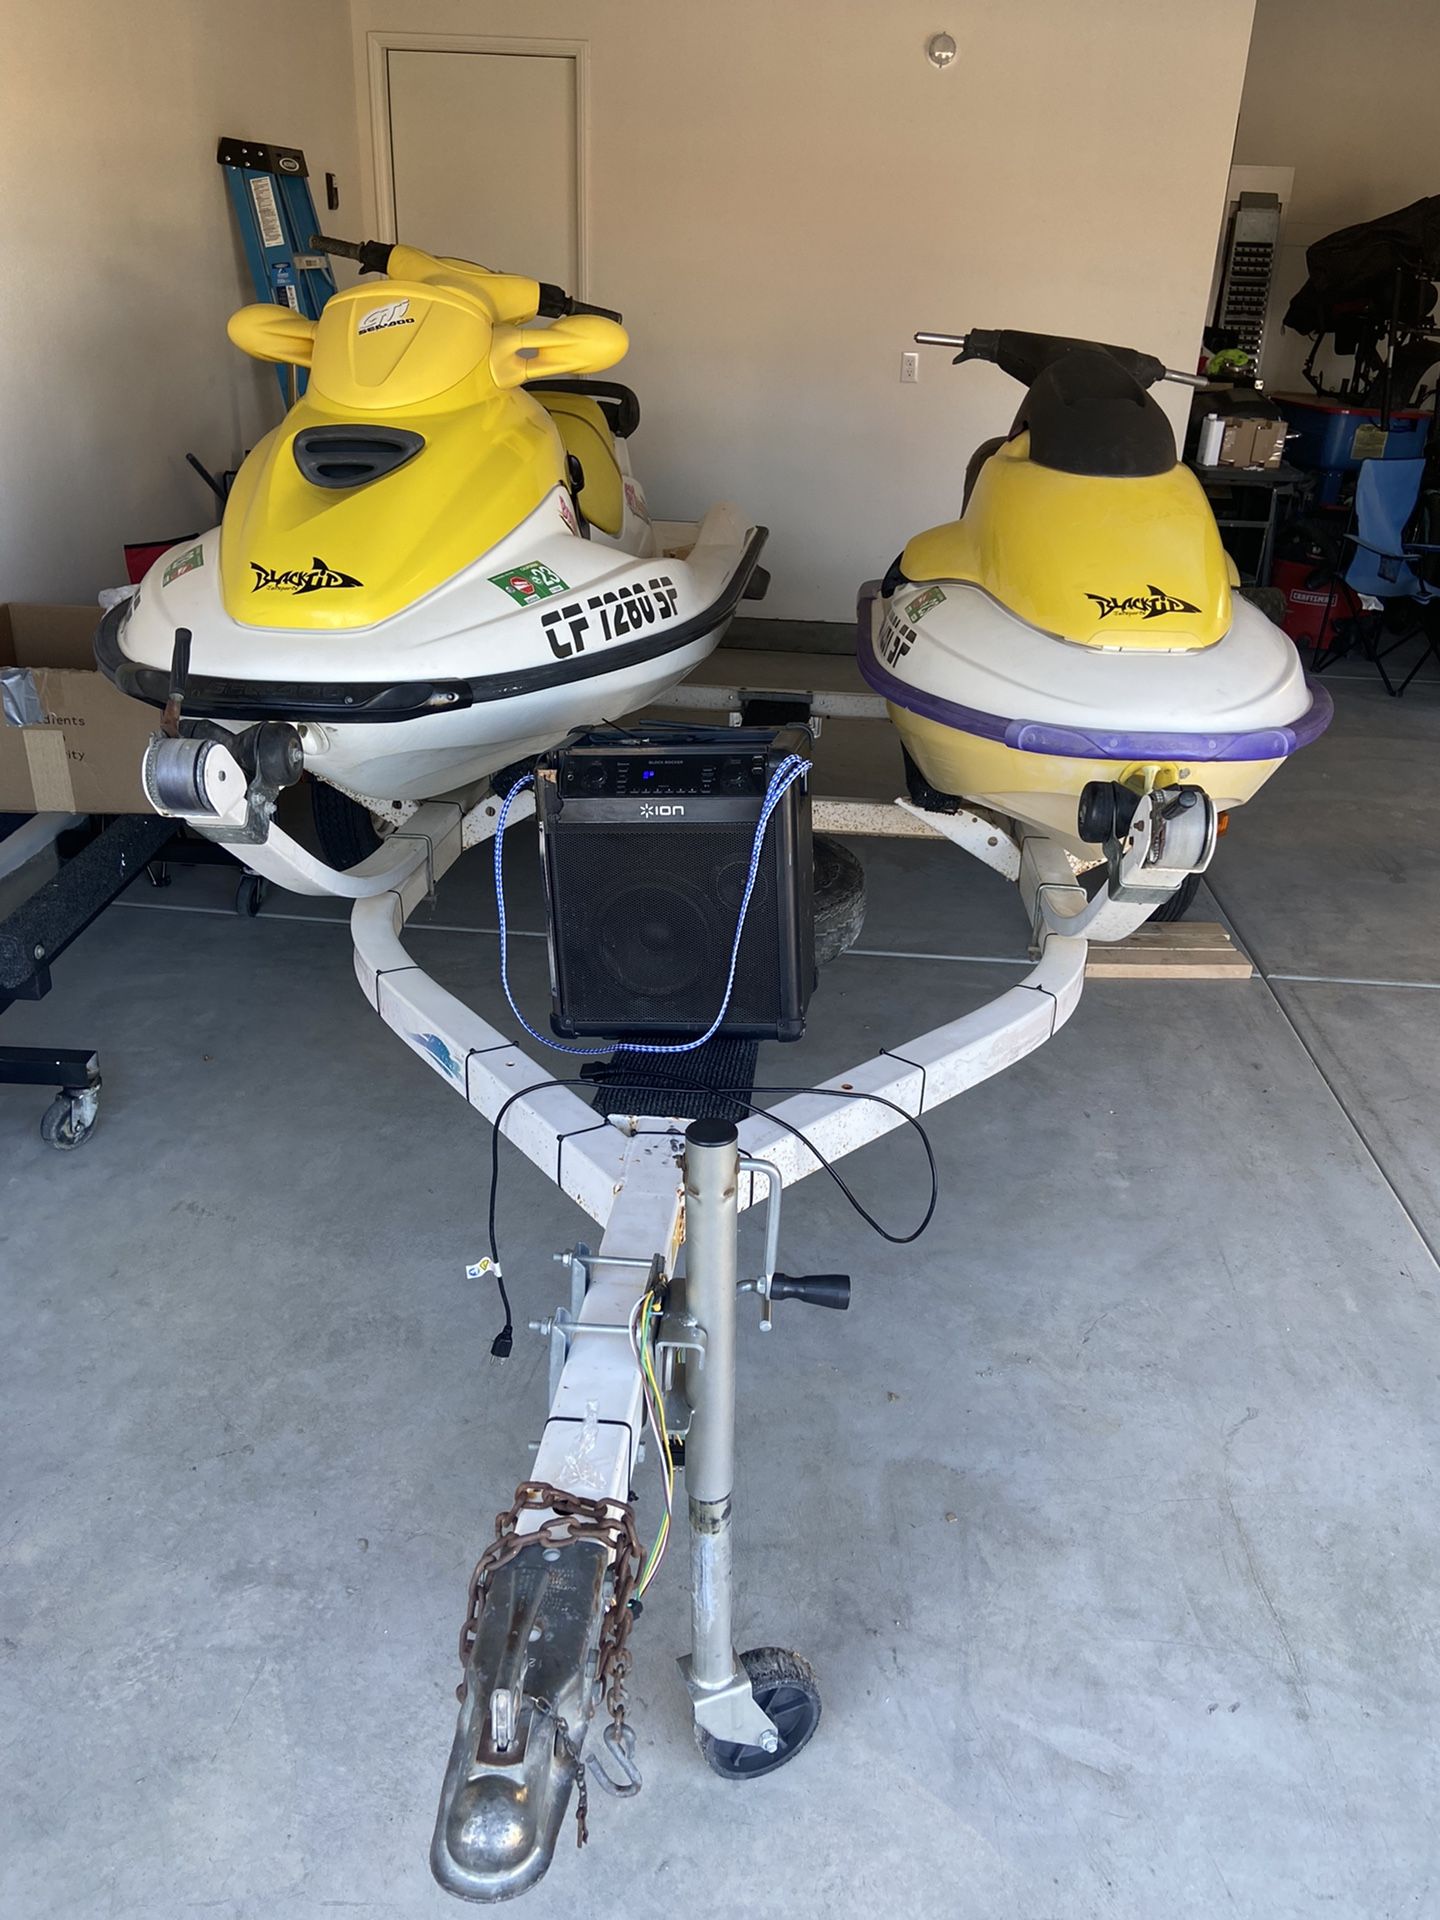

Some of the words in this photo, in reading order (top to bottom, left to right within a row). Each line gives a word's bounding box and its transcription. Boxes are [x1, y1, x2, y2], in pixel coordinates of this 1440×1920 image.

[531, 566, 560, 586] 23
[541, 603, 589, 659] CF
[36, 713, 86, 727] dients
[66, 750, 86, 761] ity
